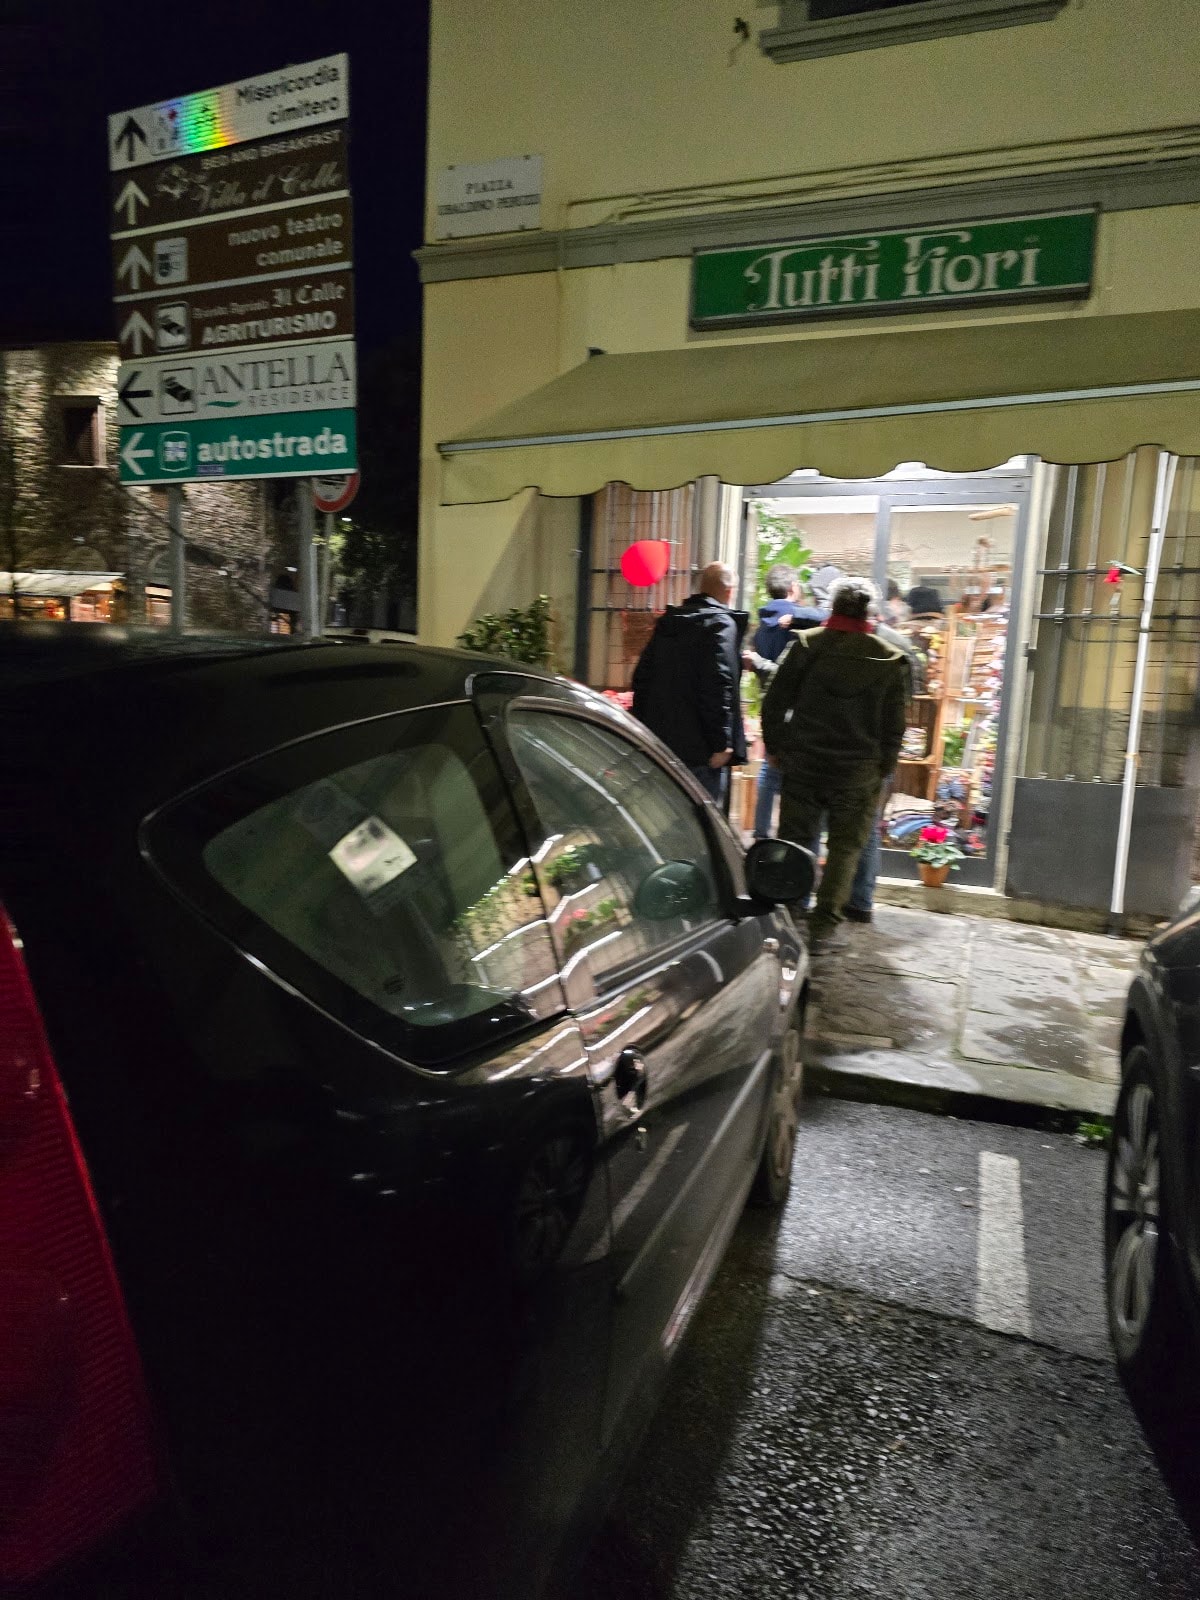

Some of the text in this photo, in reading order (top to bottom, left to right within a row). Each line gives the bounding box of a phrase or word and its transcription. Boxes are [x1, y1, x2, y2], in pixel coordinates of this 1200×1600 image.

[237, 64, 340, 104] Misericordia
[267, 96, 340, 125] cimitero
[465, 180, 513, 195] PIAZZA
[228, 213, 343, 246] nuovo teatro
[256, 237, 344, 267] comunale
[743, 231, 1042, 311] Tutti Fiori
[201, 310, 338, 345] AGRITURISMO
[200, 351, 352, 396] ANTELLA
[249, 386, 350, 409] RESIDENCE
[197, 426, 348, 462] autostrada
